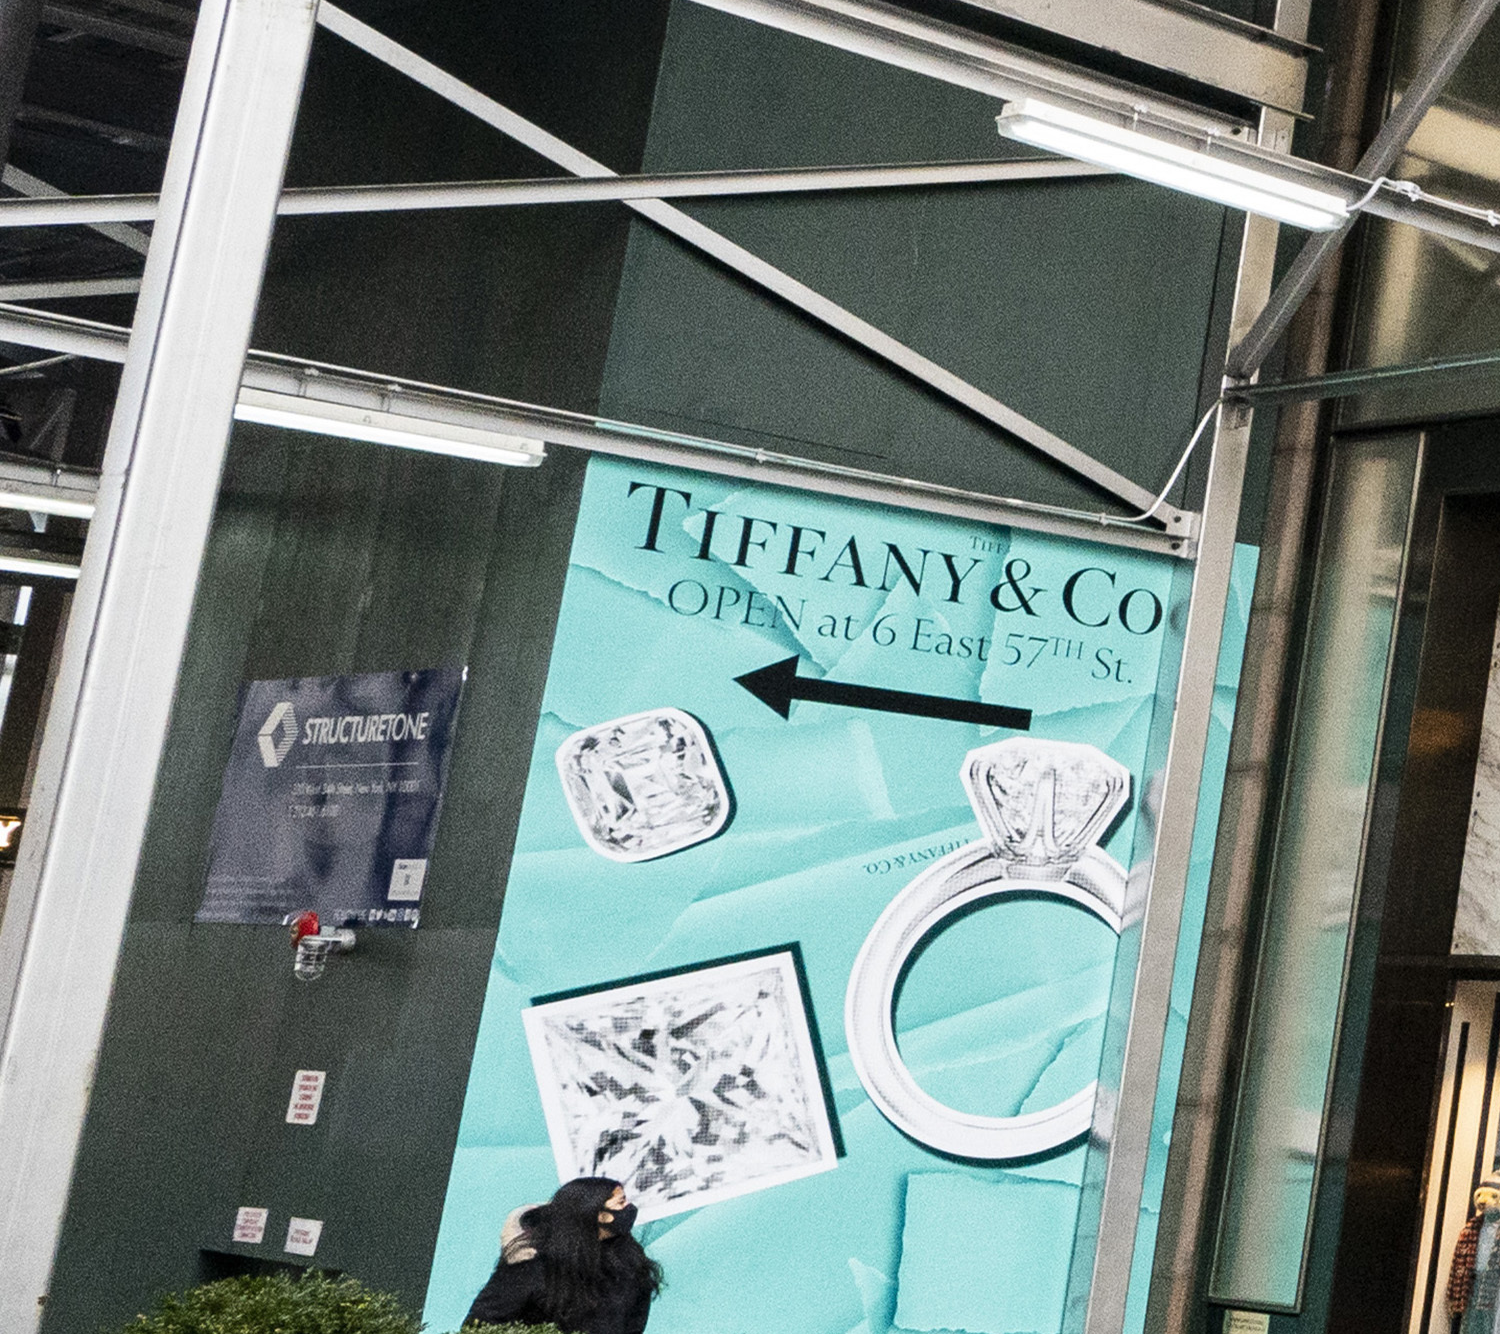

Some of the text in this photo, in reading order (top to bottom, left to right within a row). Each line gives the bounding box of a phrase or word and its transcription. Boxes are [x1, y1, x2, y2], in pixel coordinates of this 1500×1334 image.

[990, 557, 1048, 619] &
[667, 578, 806, 632] OPEN
[817, 611, 860, 644] at
[872, 613, 898, 647] 6
[911, 617, 991, 664] East
[1091, 646, 1134, 685] St.
[302, 712, 430, 745] STRUCTURETONE
